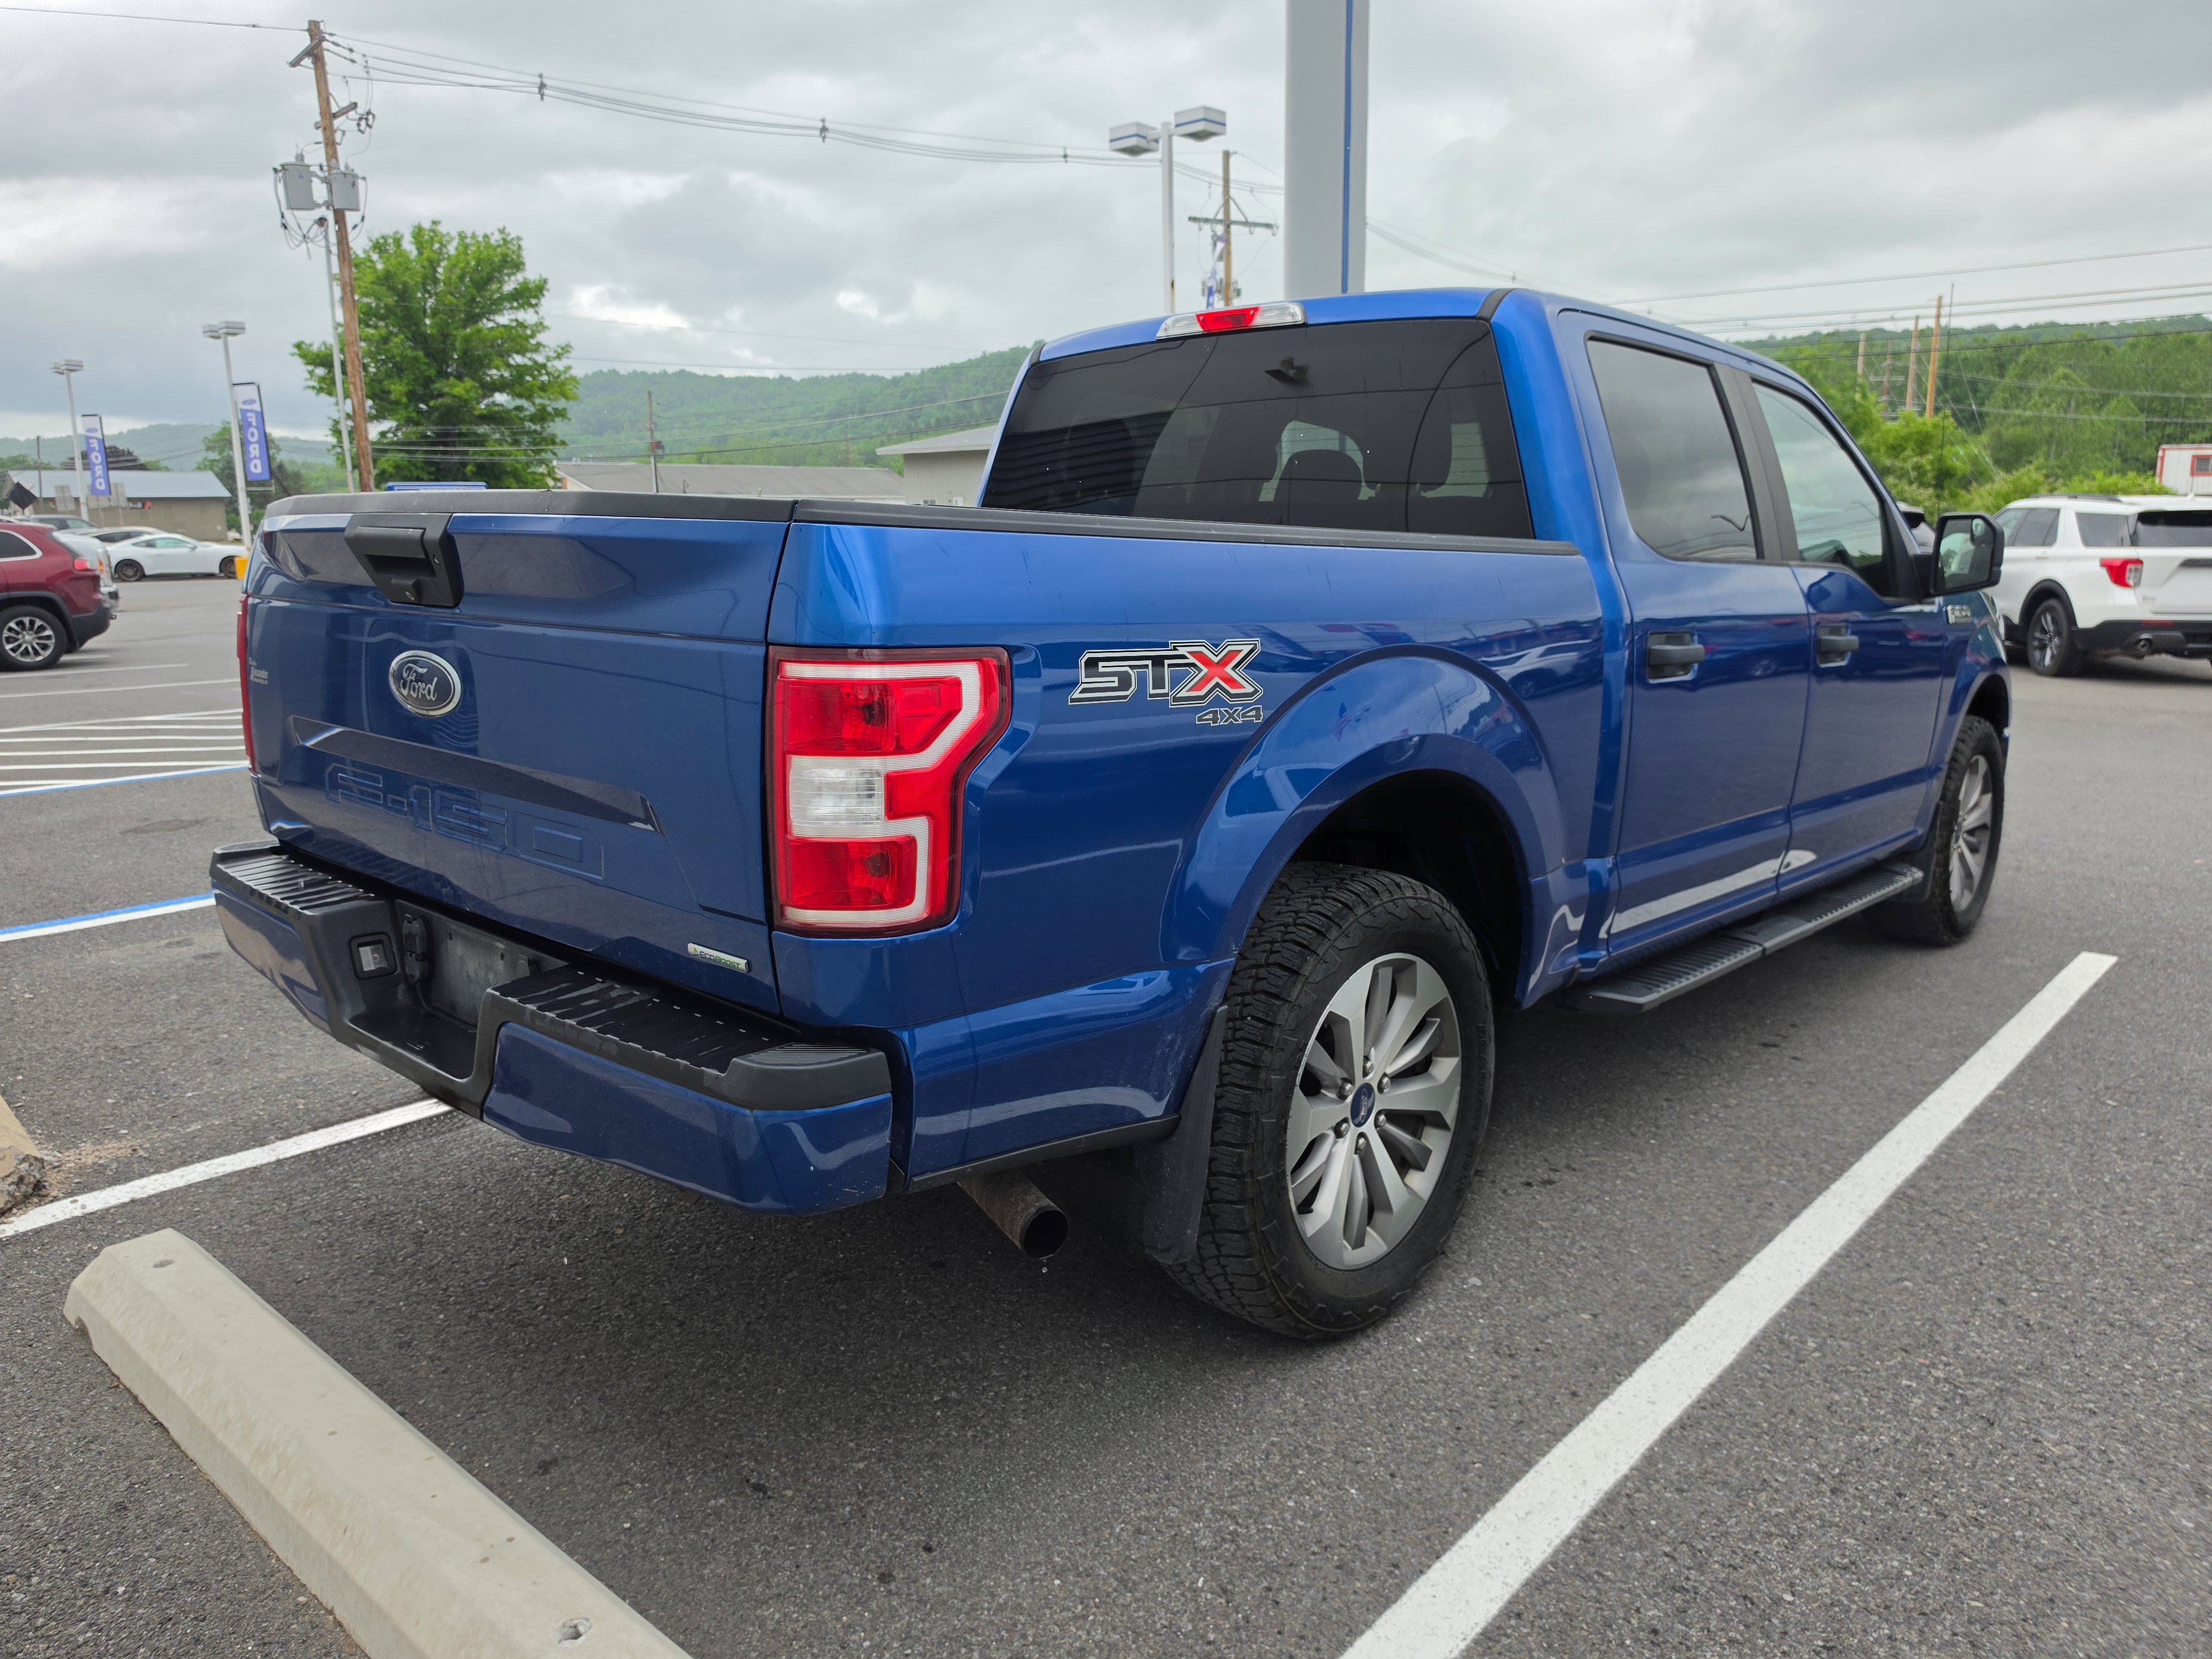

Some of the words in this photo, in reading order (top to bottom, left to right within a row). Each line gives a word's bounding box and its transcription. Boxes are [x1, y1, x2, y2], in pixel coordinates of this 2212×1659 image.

[400, 663, 437, 701] Ford
[1068, 638, 1264, 708] STX
[325, 762, 605, 881] F-150
